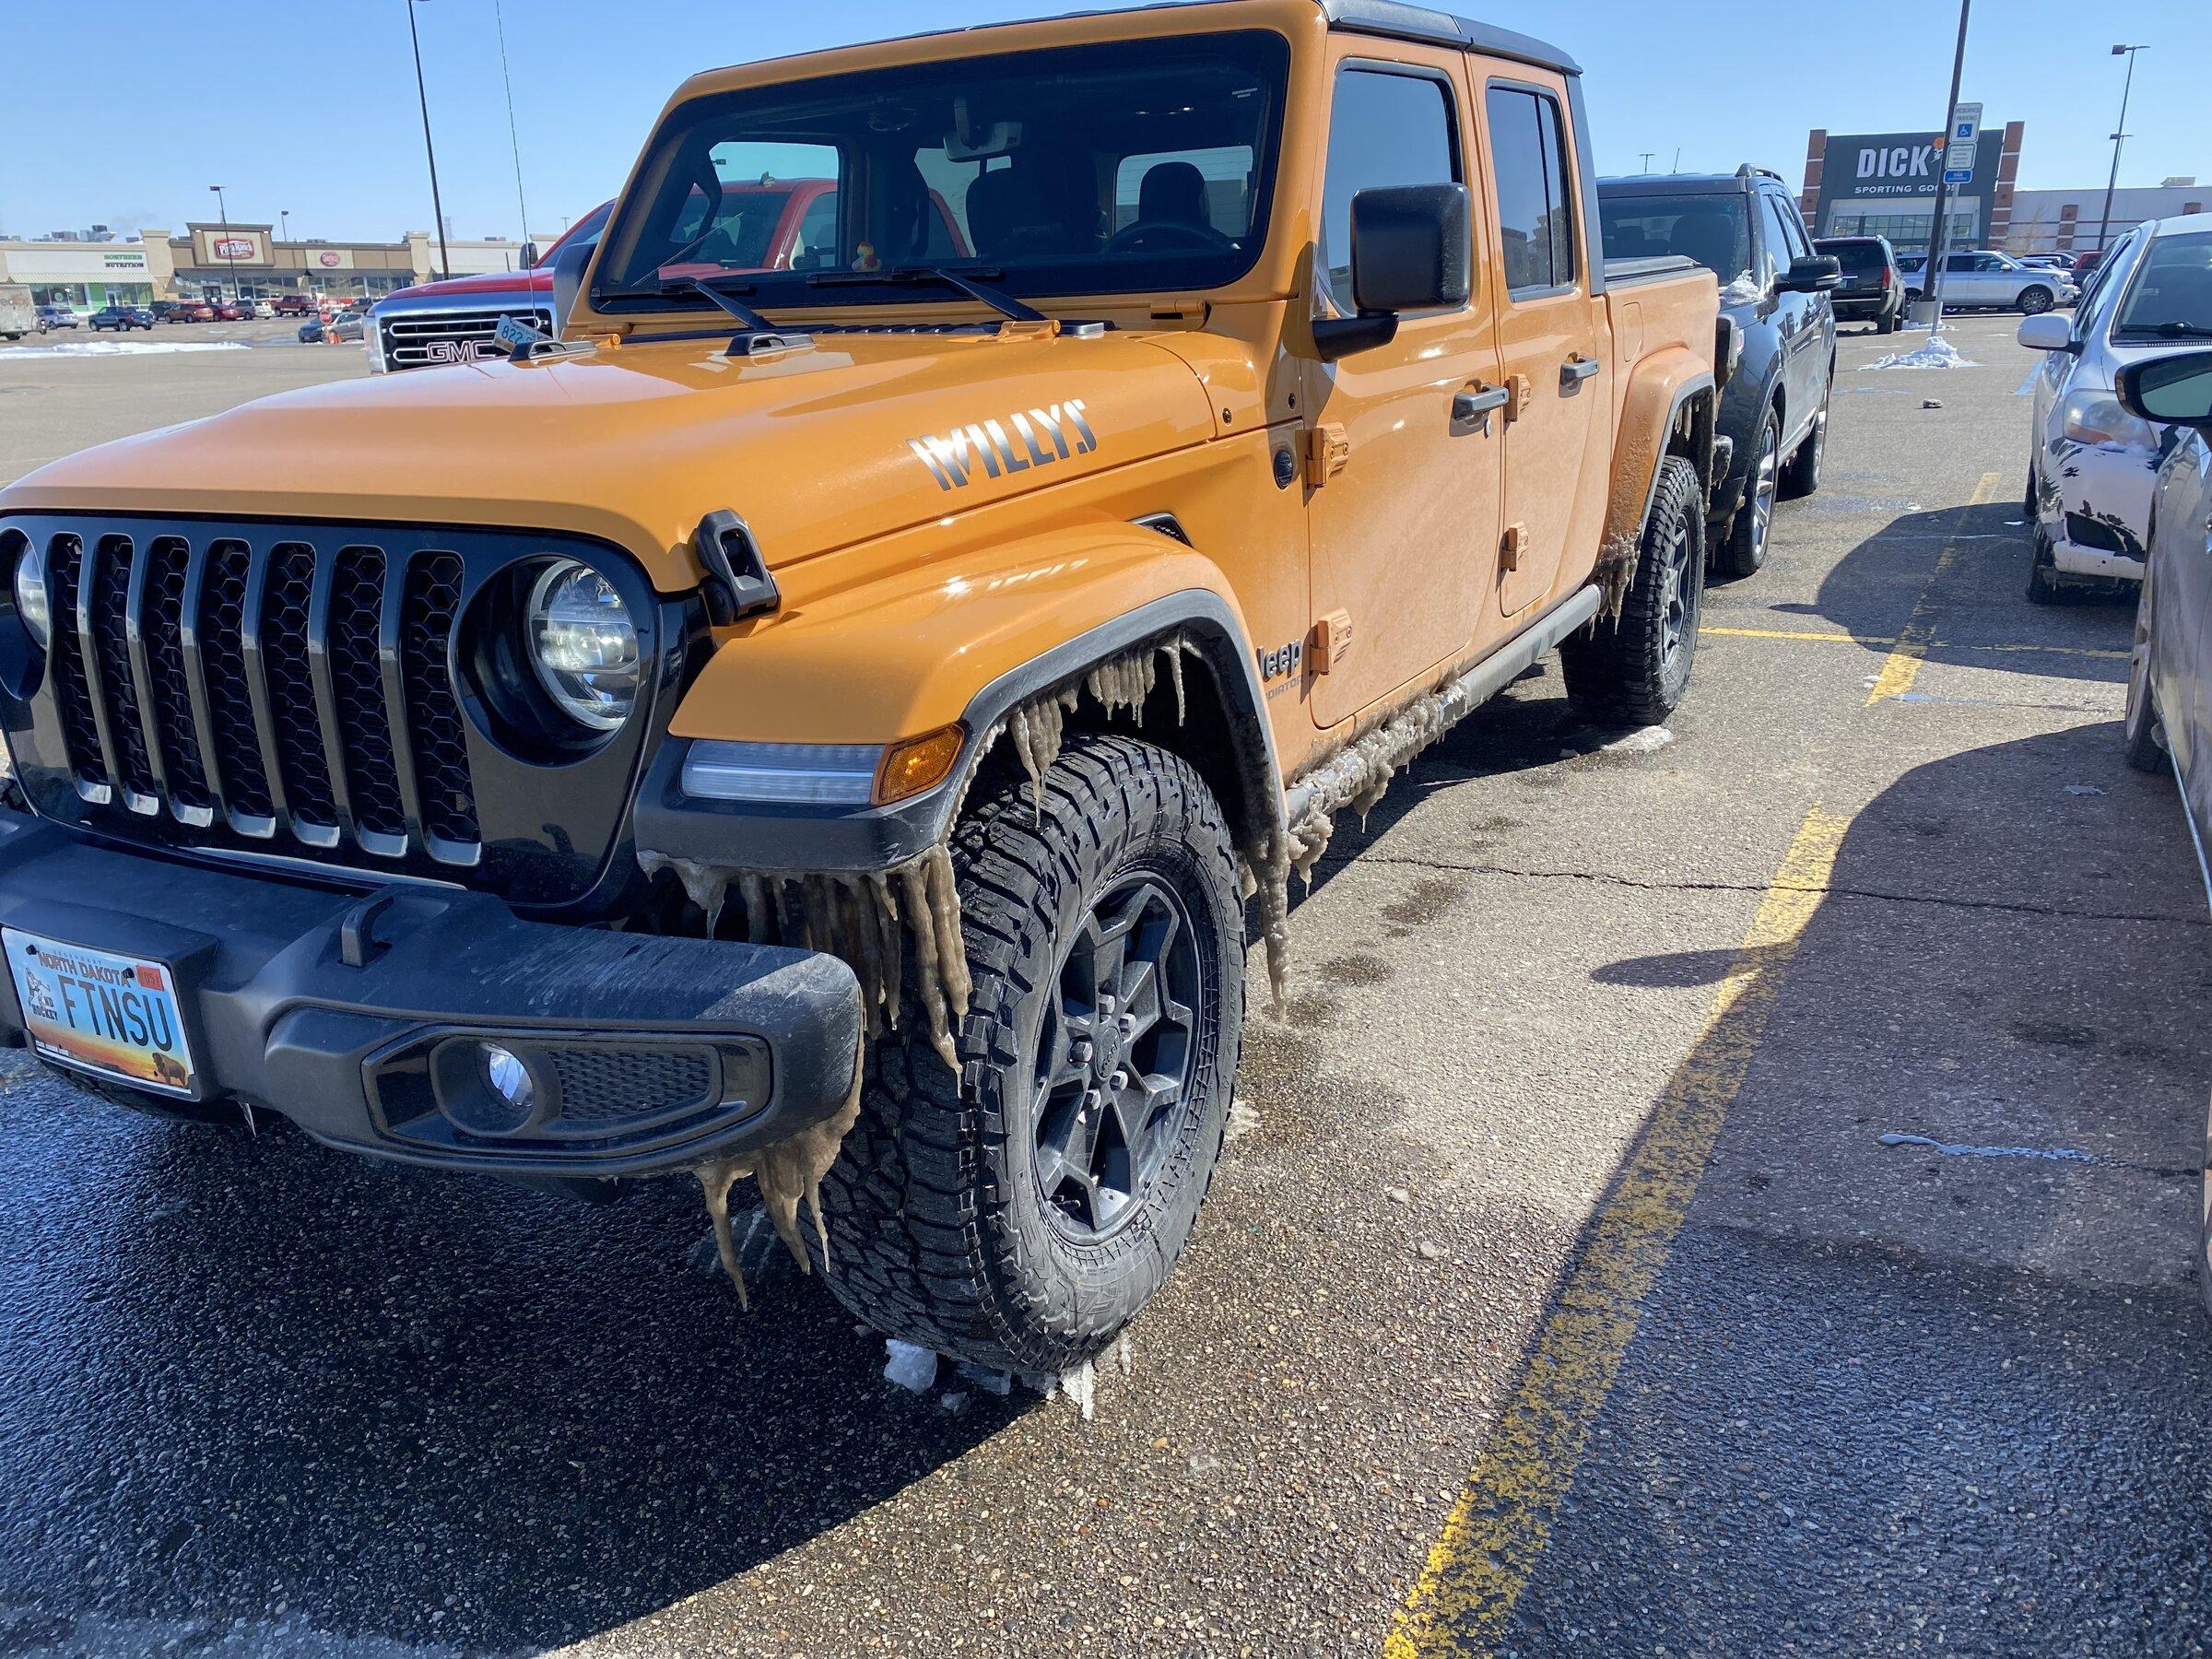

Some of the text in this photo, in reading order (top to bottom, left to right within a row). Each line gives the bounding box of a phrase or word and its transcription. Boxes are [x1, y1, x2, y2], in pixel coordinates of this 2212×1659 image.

[1854, 185, 1912, 194] SPORTING
[426, 340, 498, 363] GMC
[905, 398, 1097, 491] WILLYS
[38, 952, 132, 988] NORTH DAKOTA
[58, 974, 172, 1052] FTNSU
